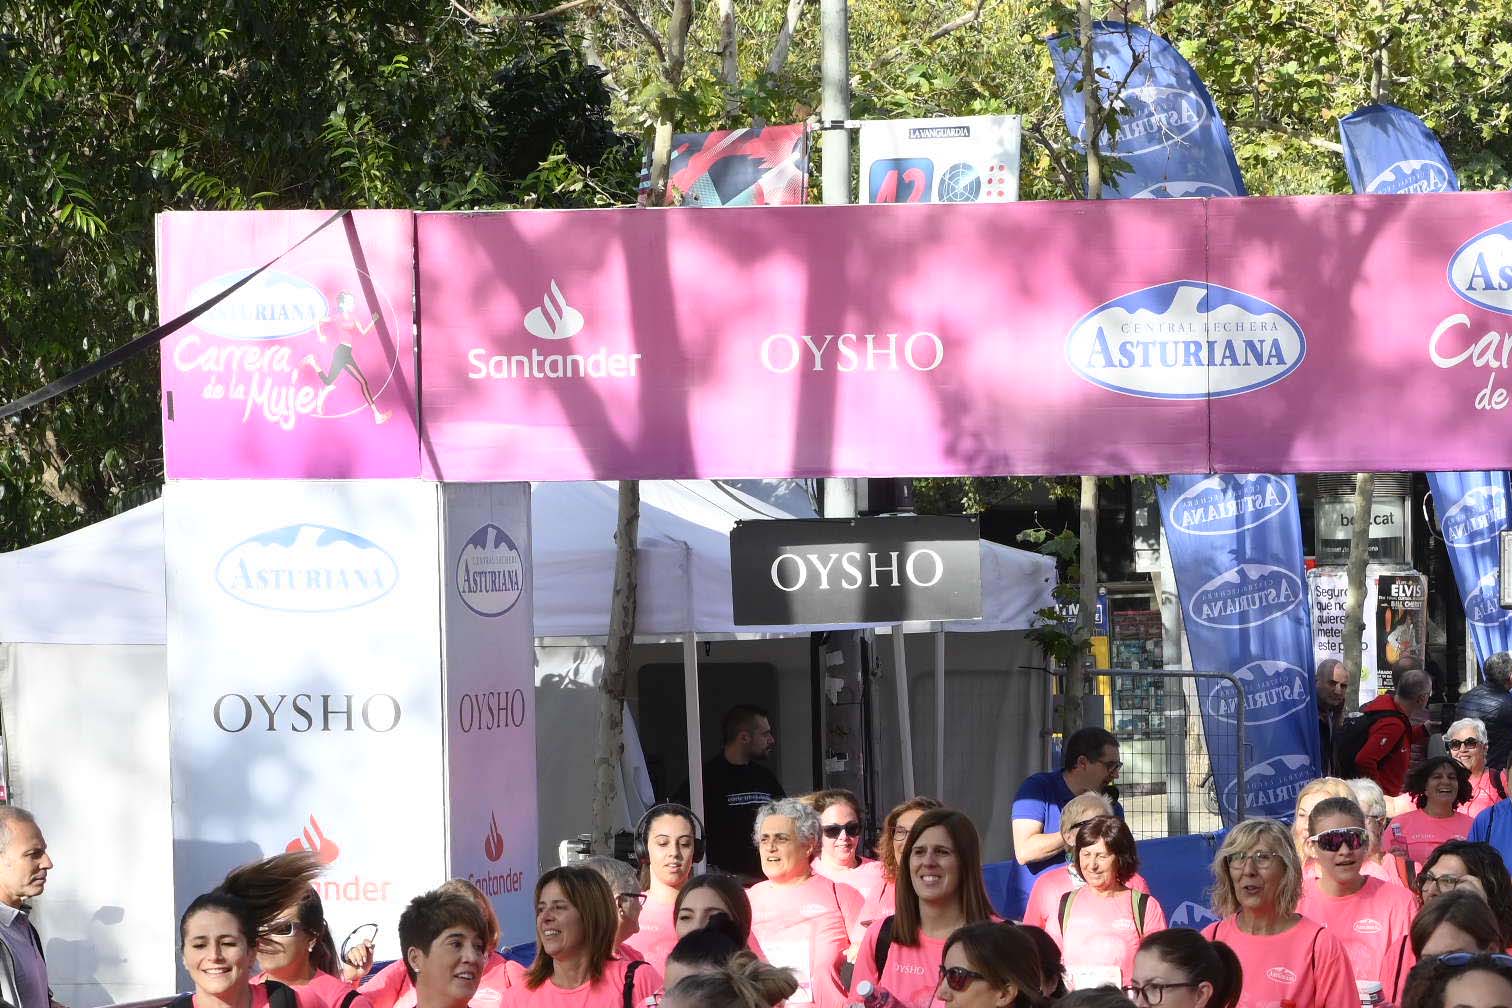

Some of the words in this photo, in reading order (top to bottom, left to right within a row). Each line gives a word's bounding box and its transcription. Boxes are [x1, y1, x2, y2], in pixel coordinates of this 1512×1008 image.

[910, 129, 921, 138] LA
[921, 126, 969, 138] VANGUARDIA
[1121, 321, 1197, 334] CENTRAL
[1204, 321, 1280, 332] LECHERA
[174, 334, 292, 372] Carrera
[468, 347, 641, 380] Santander
[761, 331, 944, 373] OYSHO
[1086, 326, 1288, 368] ASTURIANA
[201, 374, 224, 399] de
[229, 372, 246, 399] la
[243, 368, 336, 430] Mujer
[1474, 372, 1509, 410] de
[230, 557, 387, 592] ASTURIANA
[461, 562, 520, 595] ASTURIANA
[770, 547, 944, 593] OYSHO
[1316, 602, 1333, 612] que
[1391, 585, 1421, 597] ELVIS
[1319, 642, 1338, 650] este
[213, 693, 402, 733] OYSHO
[459, 688, 526, 733] OYSHO
[311, 876, 392, 903] ander
